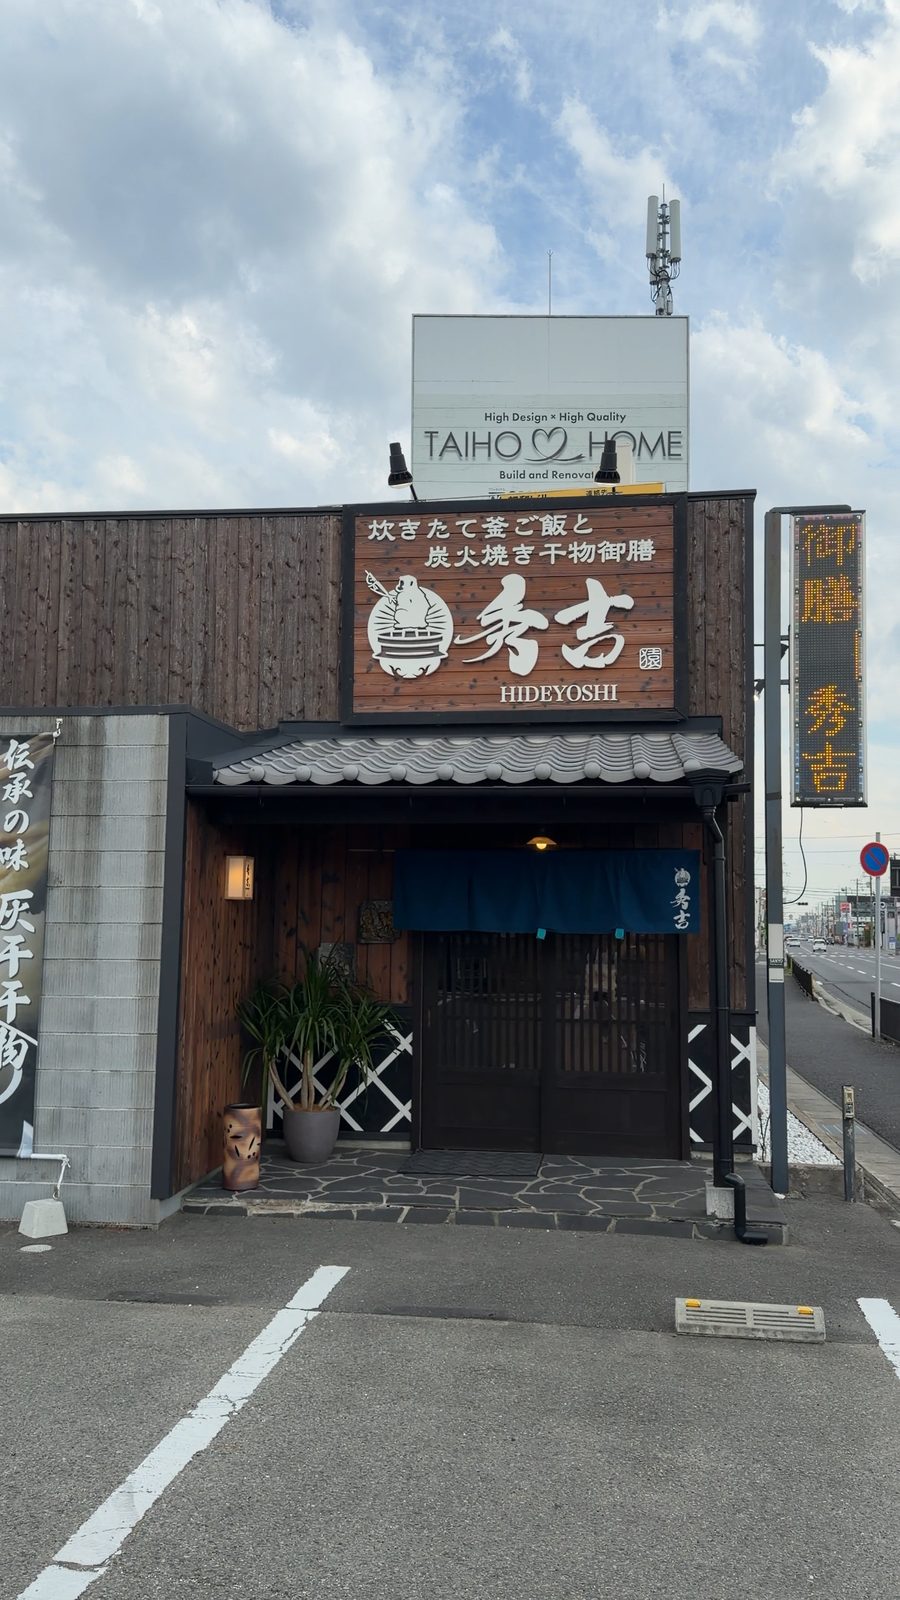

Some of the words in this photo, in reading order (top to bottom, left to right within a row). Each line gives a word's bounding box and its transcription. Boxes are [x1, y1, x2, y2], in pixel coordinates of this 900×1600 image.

[484, 412, 509, 423] High
[512, 412, 548, 423] Design
[559, 412, 584, 423] High
[586, 412, 626, 423] Quality
[424, 431, 521, 458] TAIHO
[588, 431, 682, 457] HOME
[500, 470, 526, 479] Build
[529, 470, 548, 479] and
[367, 513, 594, 542] 炊きたて釜ご飯と
[424, 539, 656, 568] 炭火焼き干物御膳
[454, 573, 635, 677] 秀吉
[499, 684, 618, 703] HIDEYOSHI
[801, 685, 856, 793] 秀吉
[0, 738, 35, 871] 伝承の味
[670, 888, 691, 930] 秀吉
